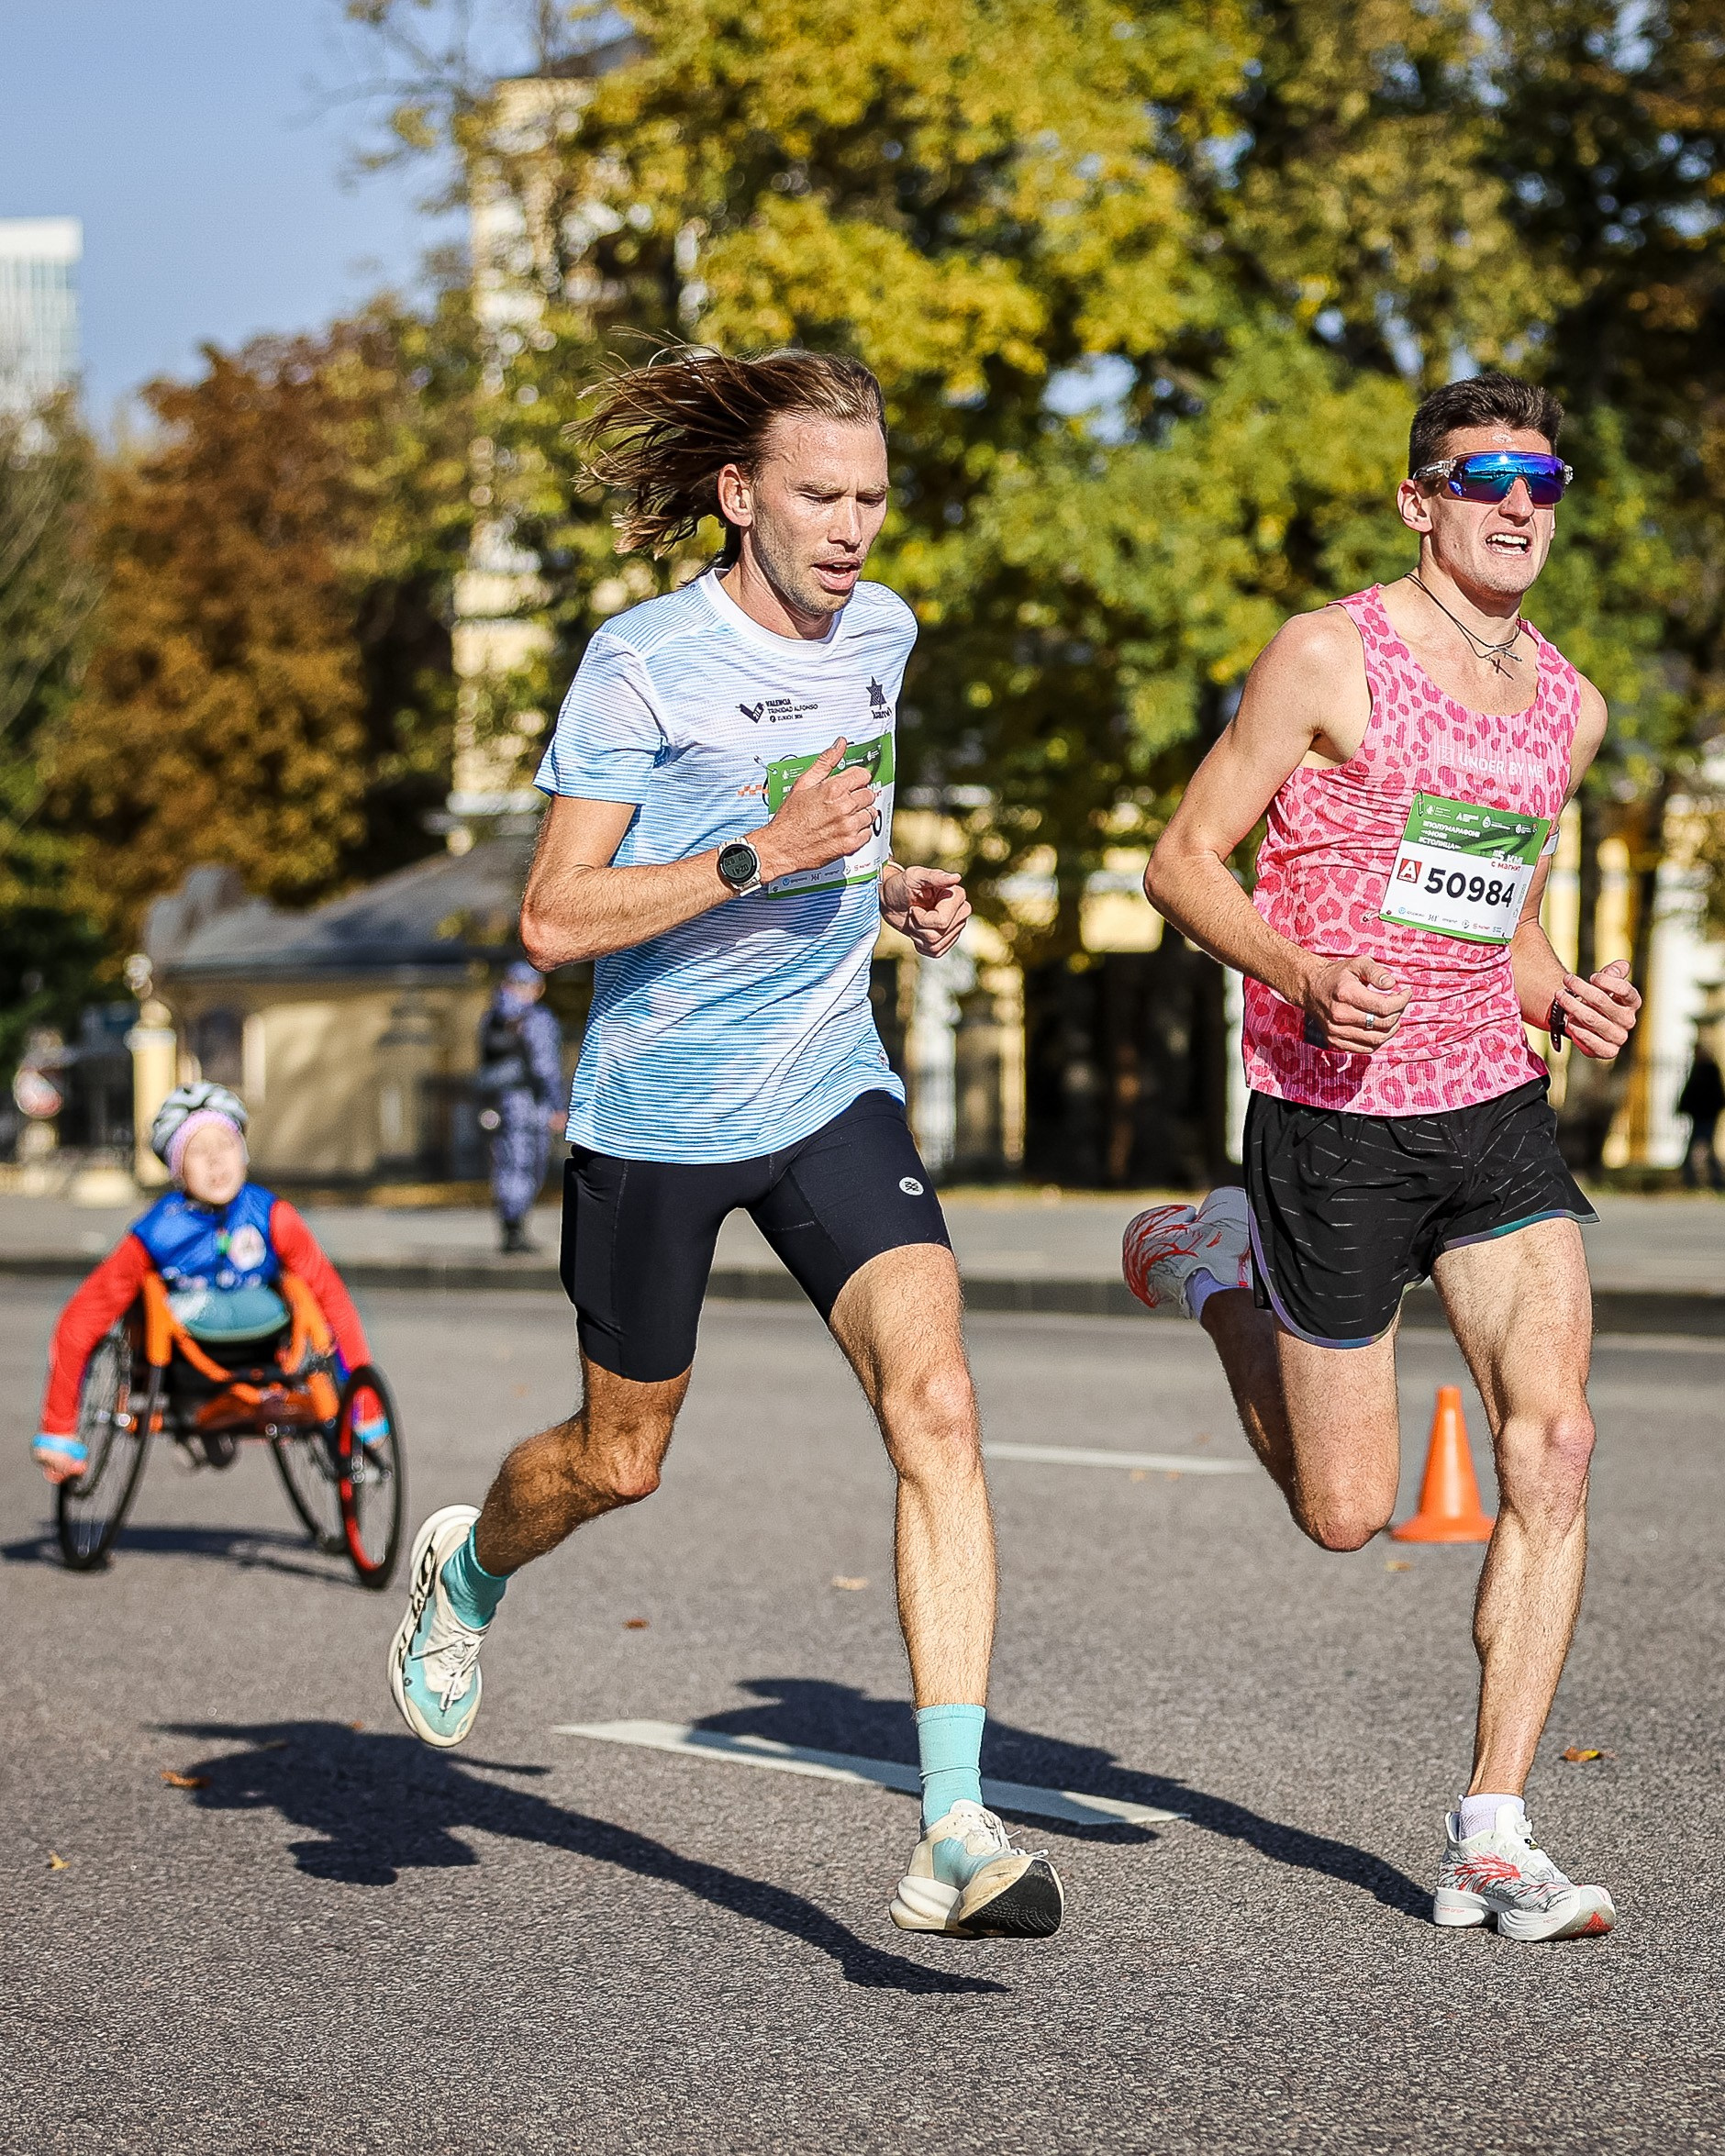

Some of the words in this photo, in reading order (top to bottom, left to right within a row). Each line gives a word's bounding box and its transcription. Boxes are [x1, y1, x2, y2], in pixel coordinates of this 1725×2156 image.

[765, 698, 792, 707] VALENCIA
[1460, 752, 1505, 774] UNDER
[1508, 761, 1524, 775] BY
[1528, 763, 1543, 778] ME
[1424, 867, 1516, 908] 50984
